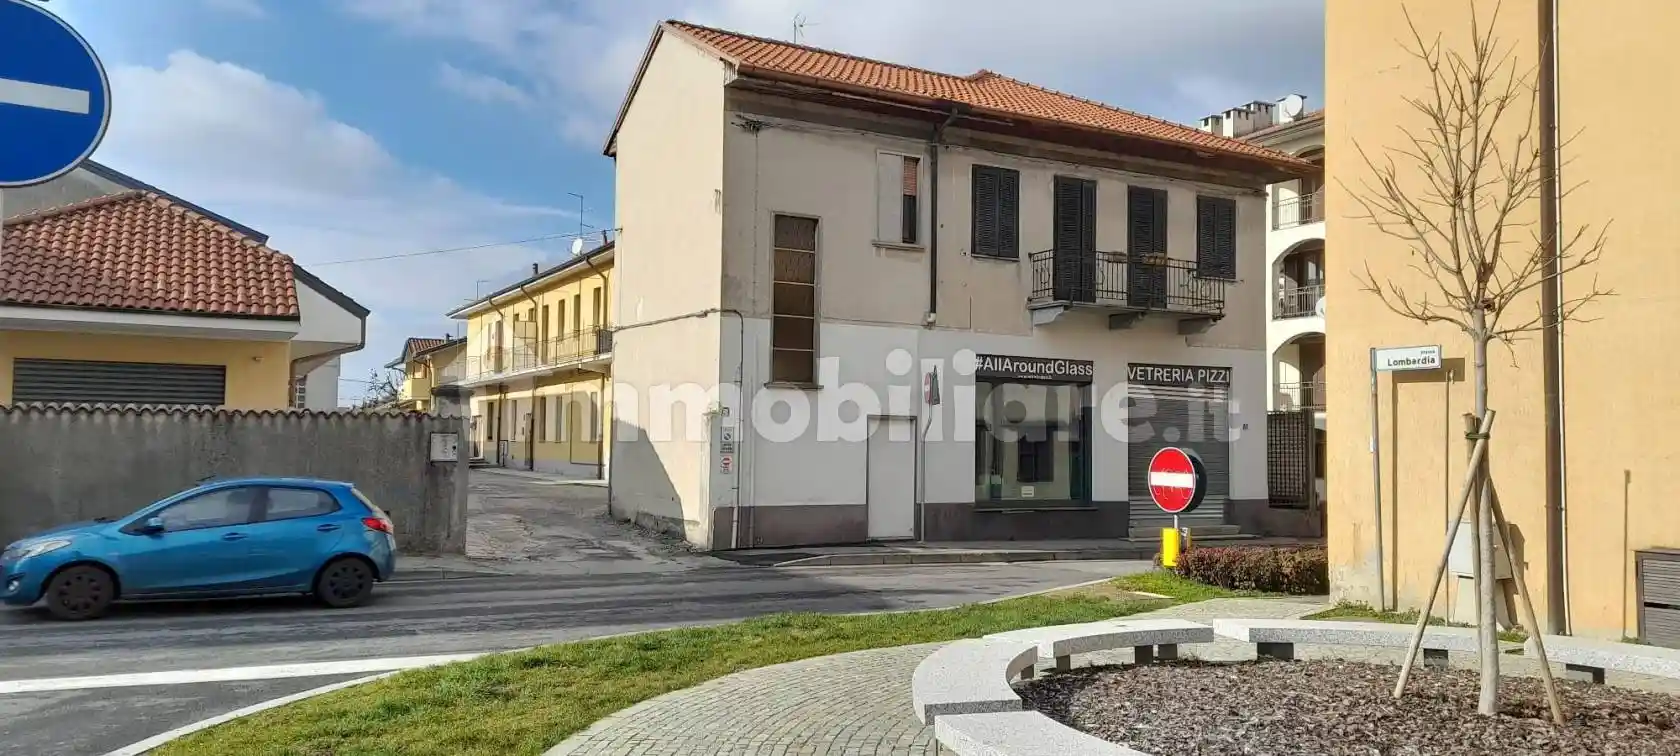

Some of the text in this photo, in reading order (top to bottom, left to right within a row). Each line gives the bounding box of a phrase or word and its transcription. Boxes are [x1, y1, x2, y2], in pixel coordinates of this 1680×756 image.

[975, 356, 1093, 376] #AllAroundGlass
[1387, 355, 1436, 367] Lombardia
[1127, 366, 1230, 383] VETRERIA PIZZI
